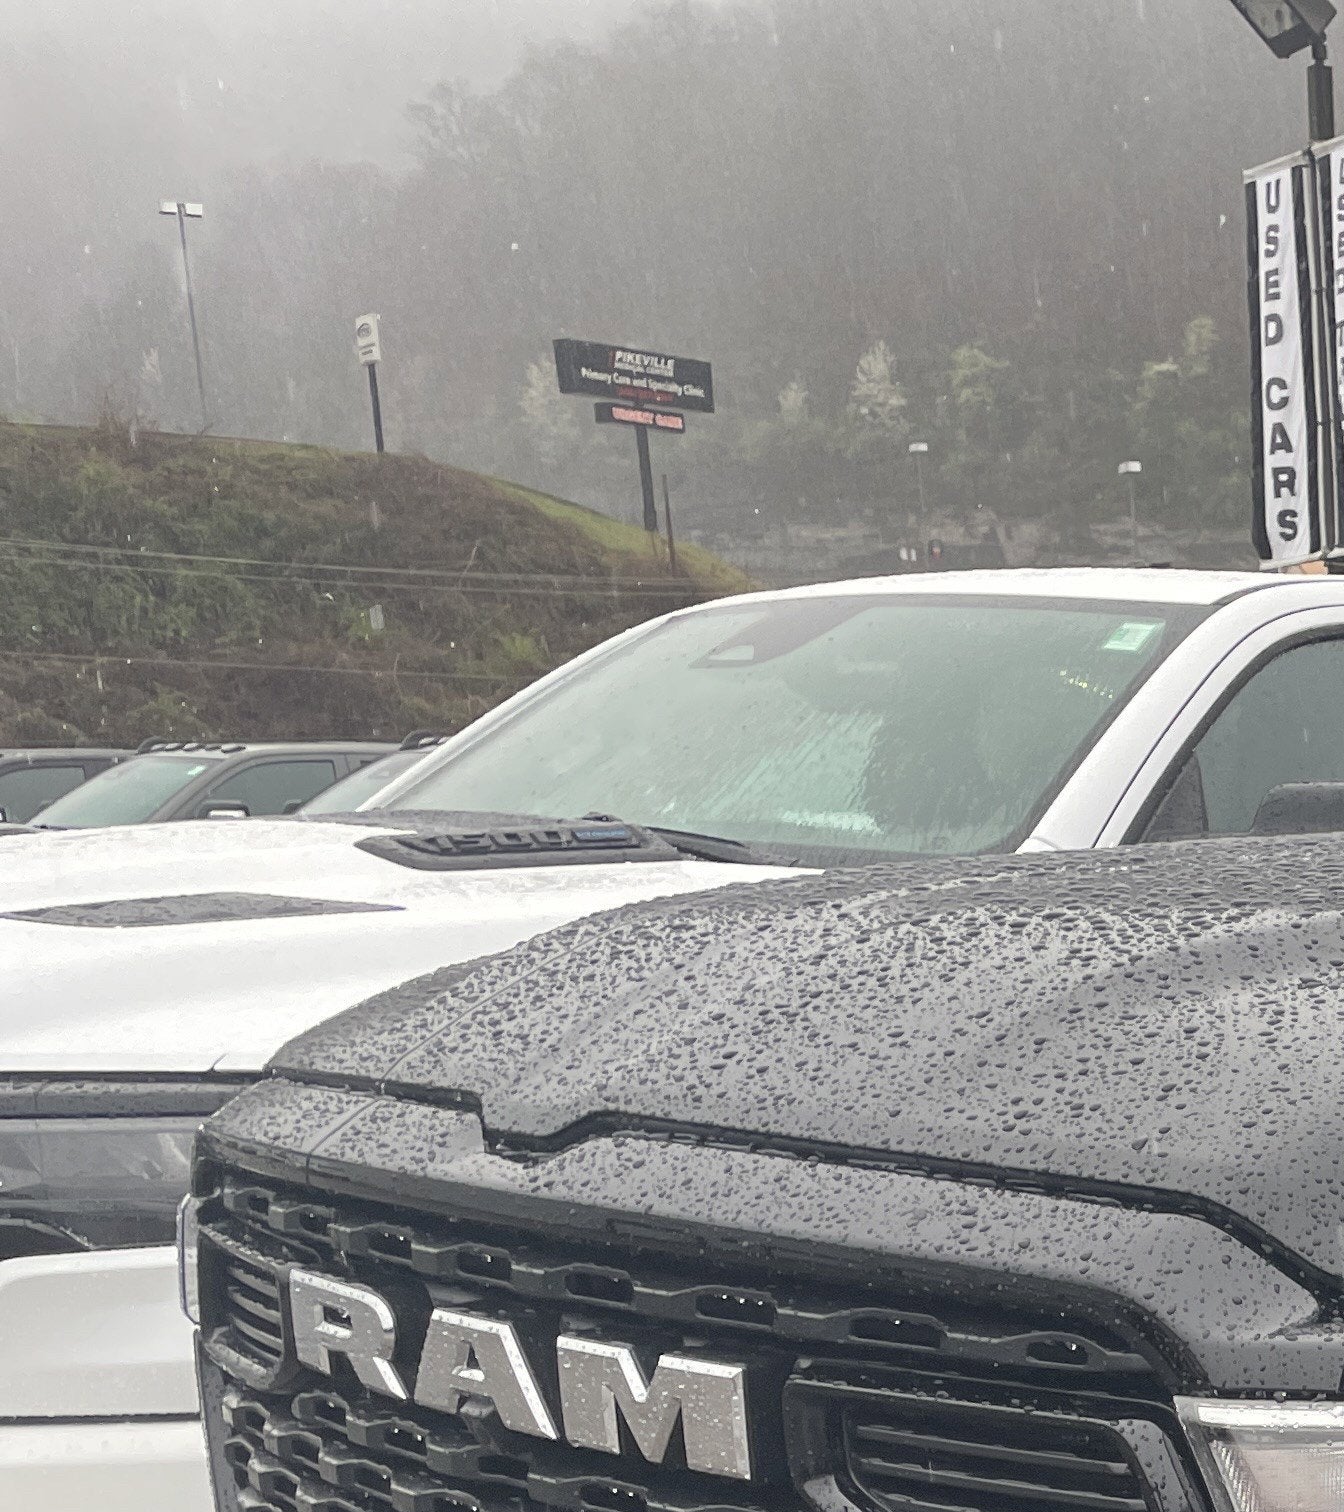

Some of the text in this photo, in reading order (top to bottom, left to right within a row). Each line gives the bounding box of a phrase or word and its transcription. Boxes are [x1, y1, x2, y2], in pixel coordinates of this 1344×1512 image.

[1265, 179, 1299, 542] USED CARS
[289, 1268, 752, 1480] RAM
